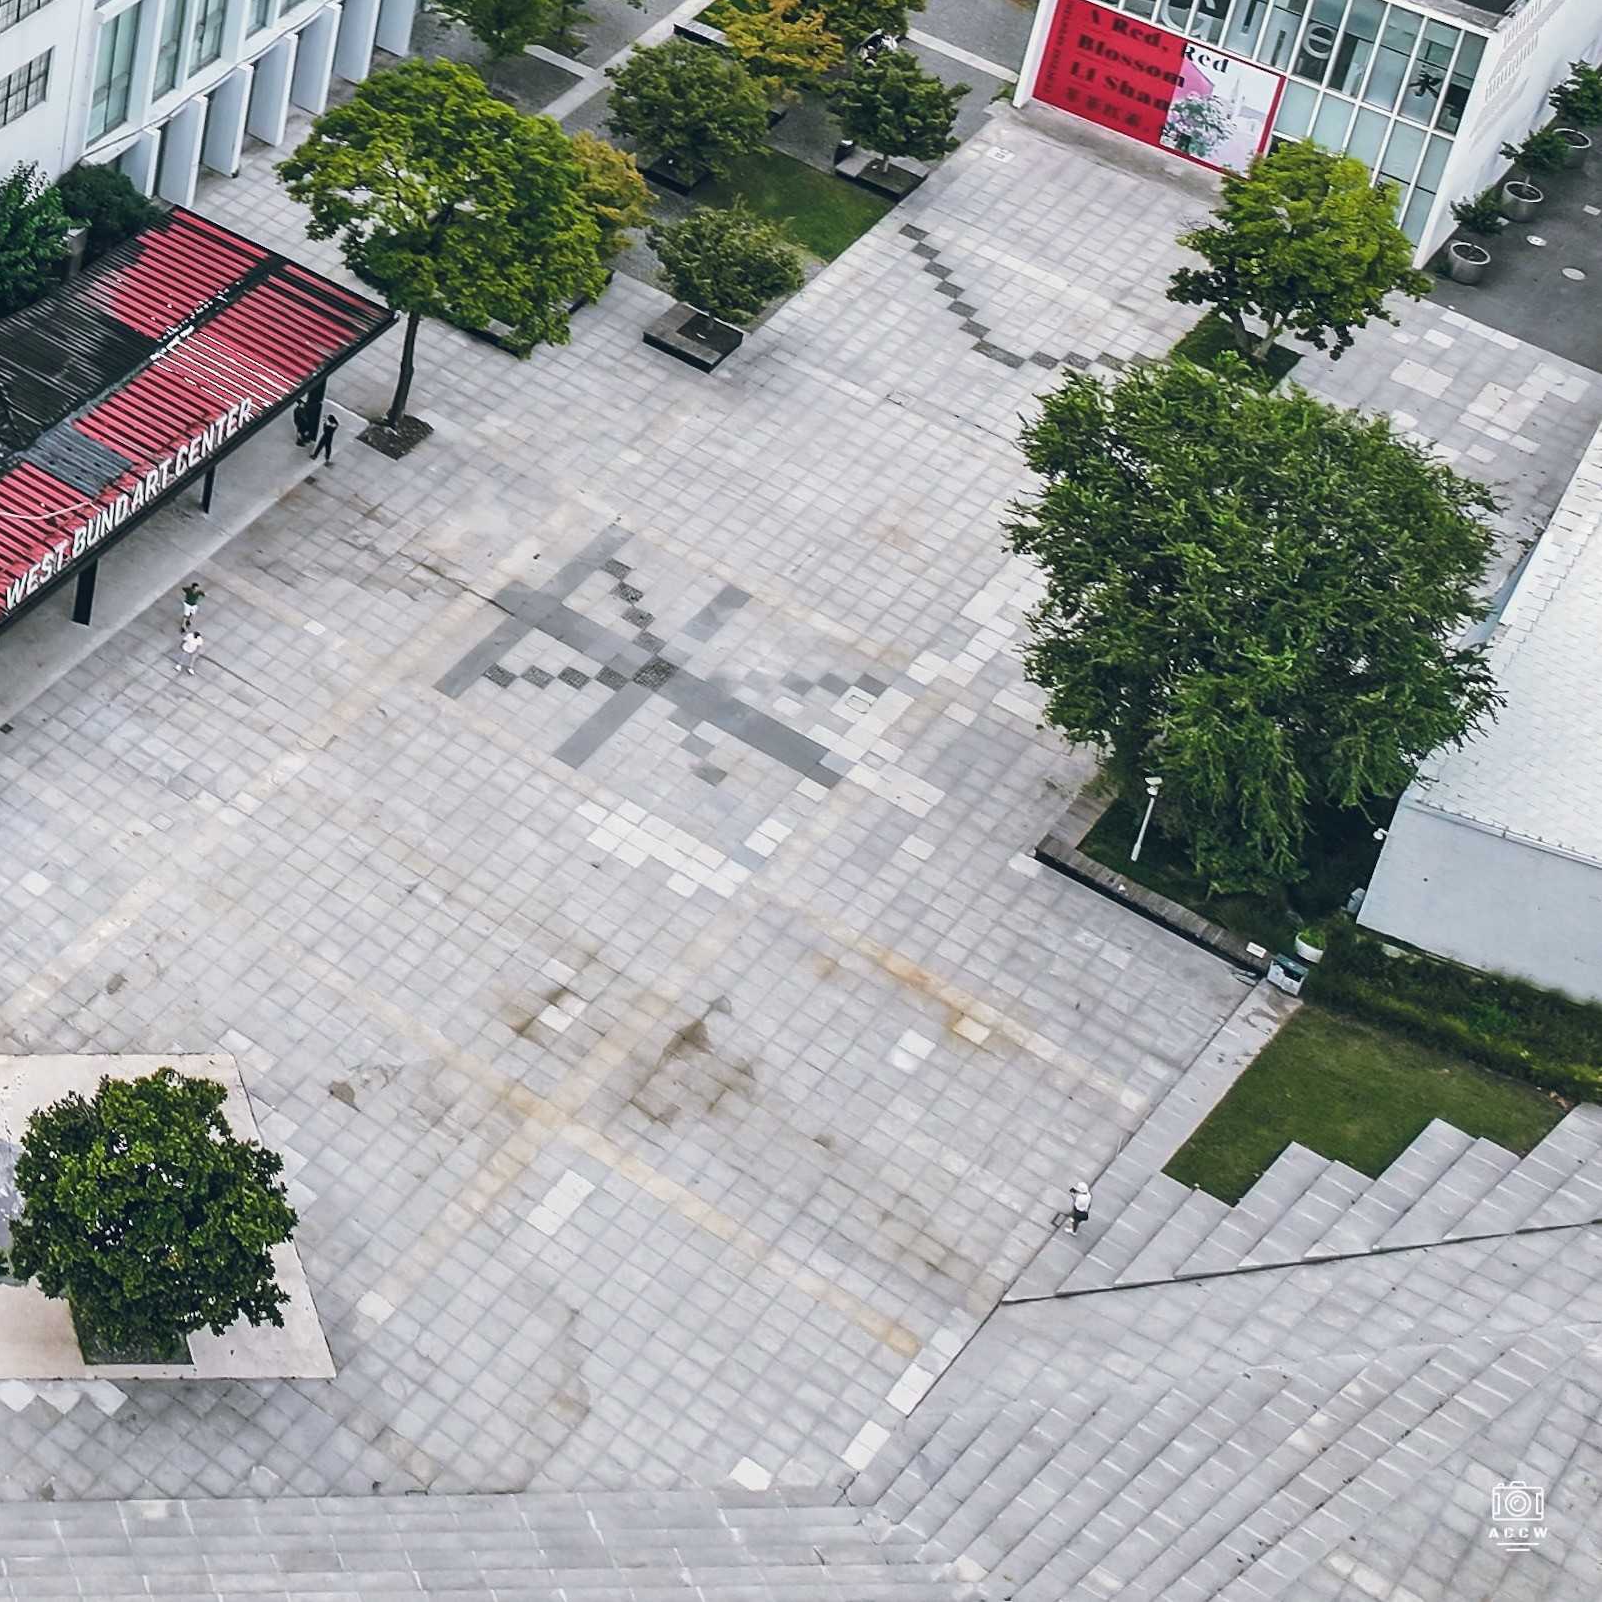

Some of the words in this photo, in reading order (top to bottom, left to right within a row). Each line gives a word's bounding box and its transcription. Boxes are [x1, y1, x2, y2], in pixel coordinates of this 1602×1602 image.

[1077, 34, 1186, 88] Blossom
[5, 539, 69, 610] WEST
[72, 494, 130, 555] BUND
[131, 462, 171, 511] ART
[174, 397, 254, 476] CENTER
